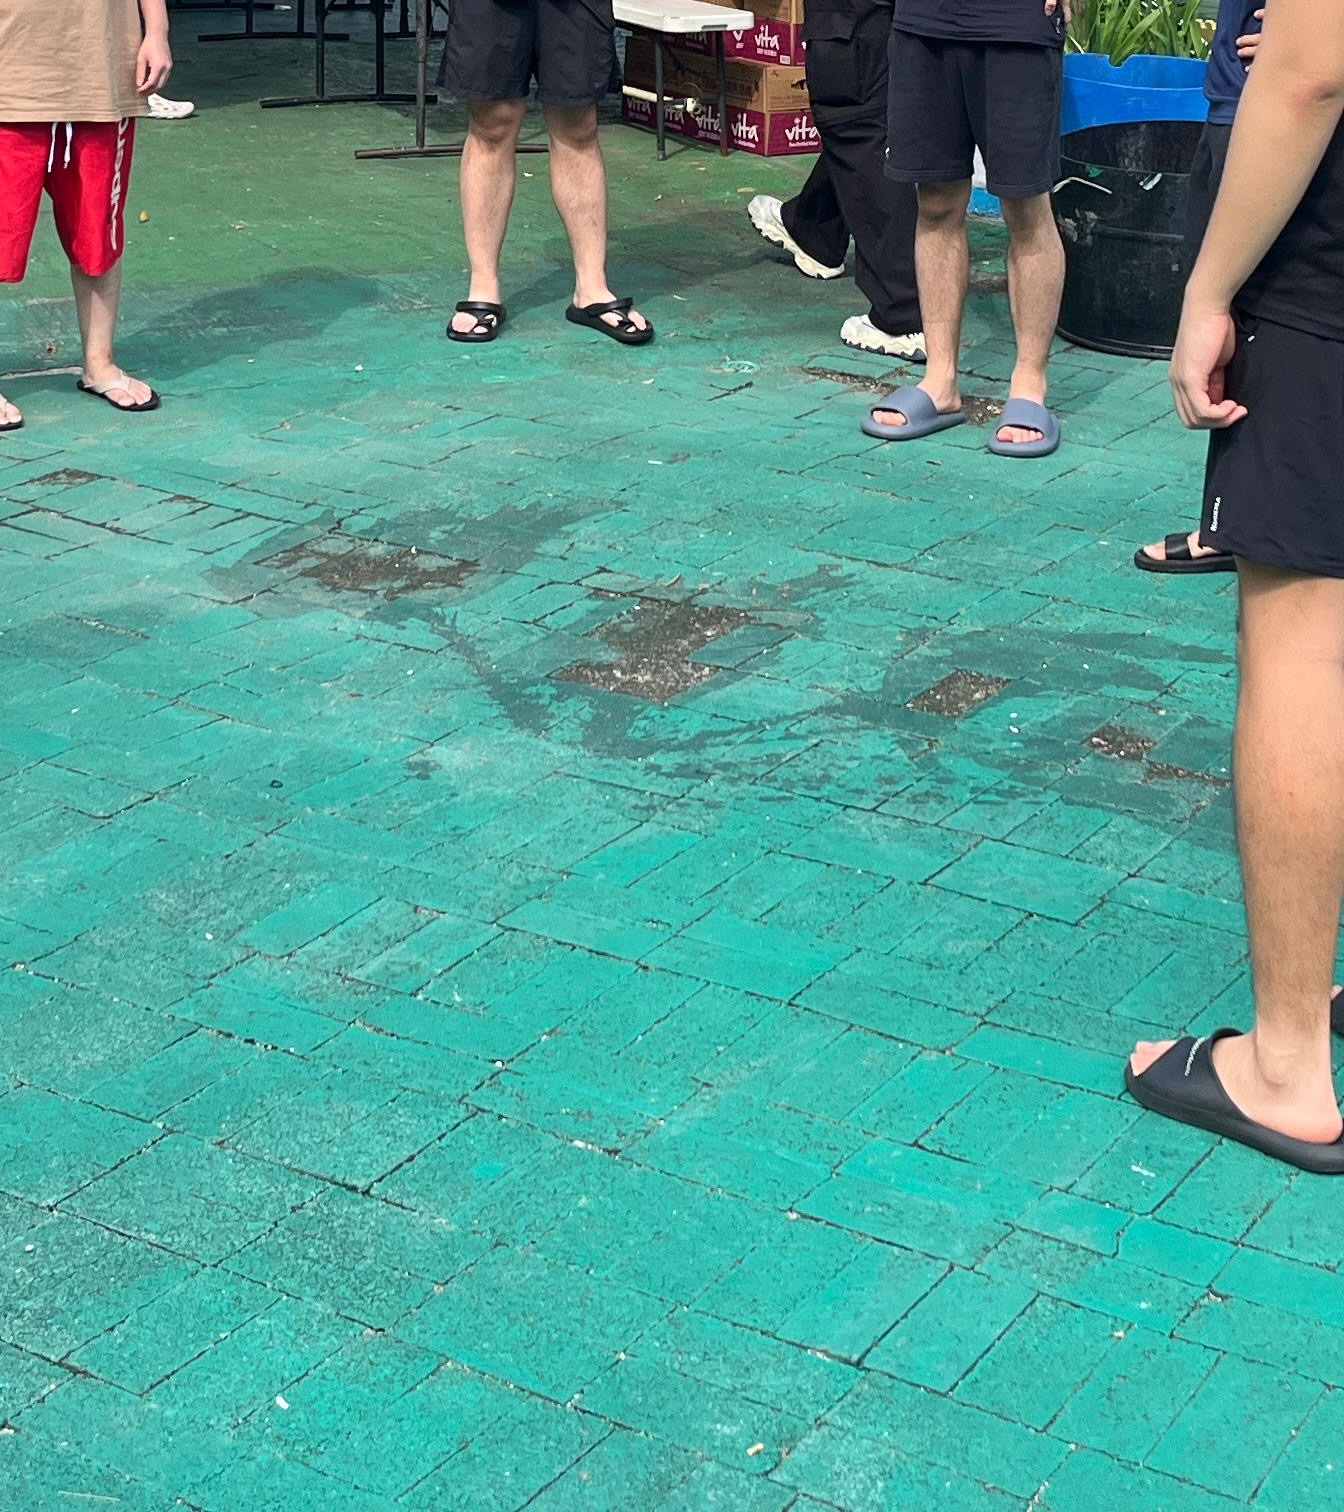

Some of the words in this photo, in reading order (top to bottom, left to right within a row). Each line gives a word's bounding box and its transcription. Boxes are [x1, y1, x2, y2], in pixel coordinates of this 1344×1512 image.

[754, 24, 780, 50] vita
[731, 113, 759, 142] vita
[785, 116, 821, 140] vita
